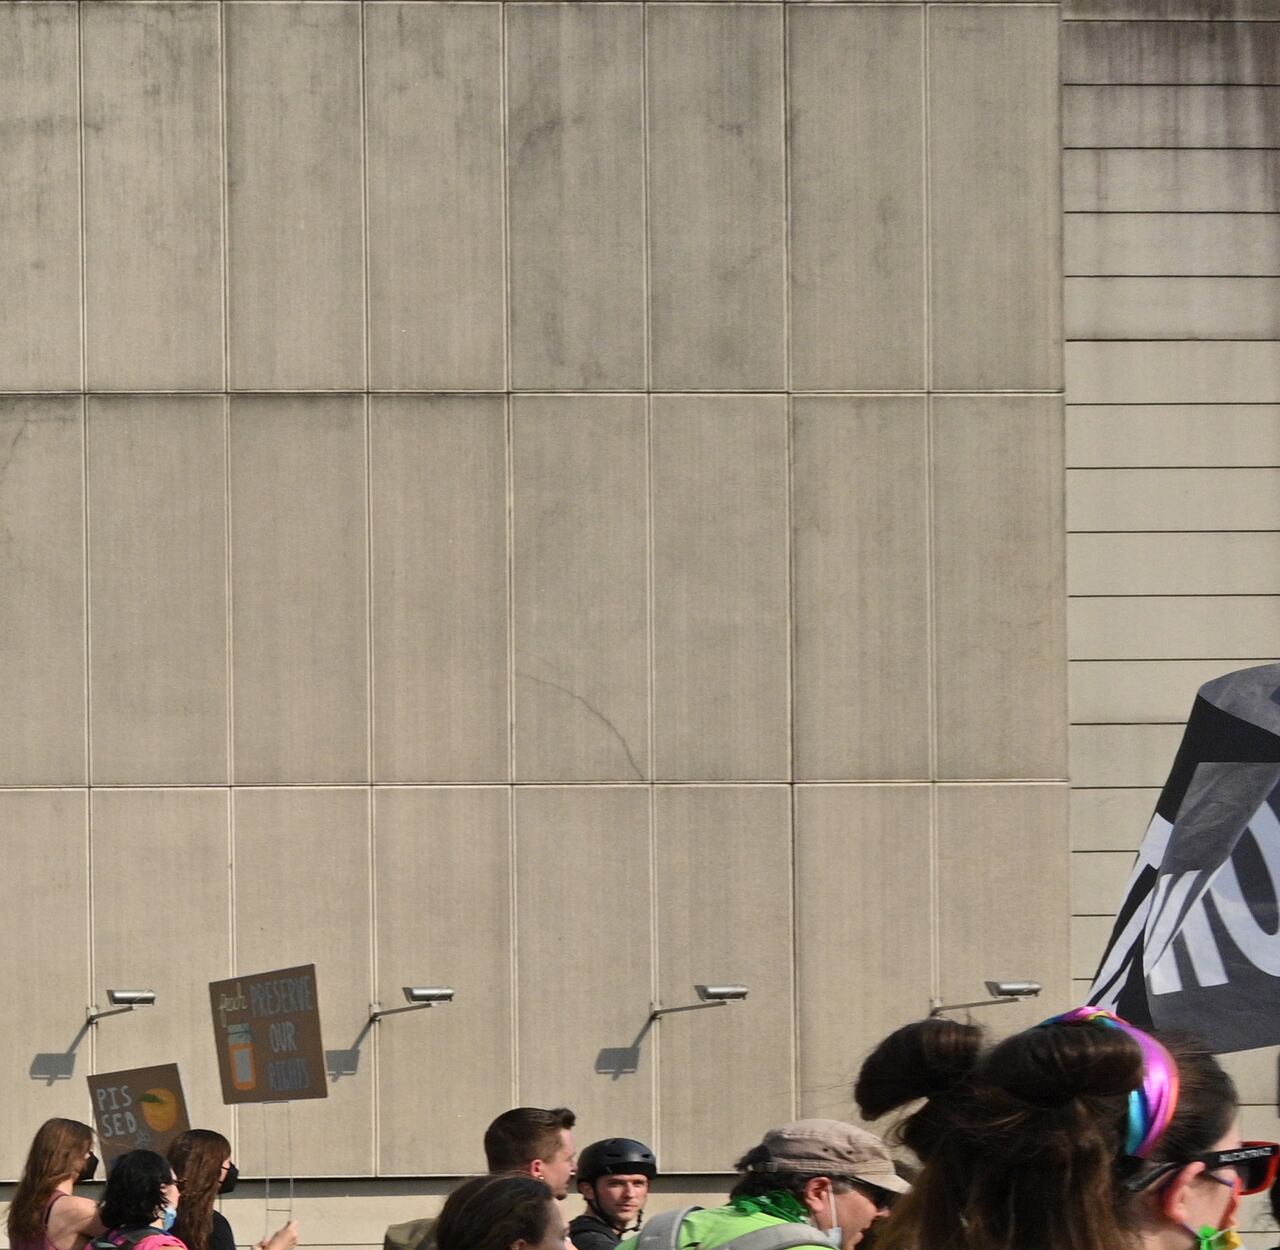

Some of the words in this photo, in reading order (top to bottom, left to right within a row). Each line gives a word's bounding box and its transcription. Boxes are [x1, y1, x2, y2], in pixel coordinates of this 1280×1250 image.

[249, 975, 314, 1019] PRESERVE
[269, 1021, 298, 1054] OUR
[96, 1084, 133, 1112] PIS
[101, 1111, 138, 1138] SED
